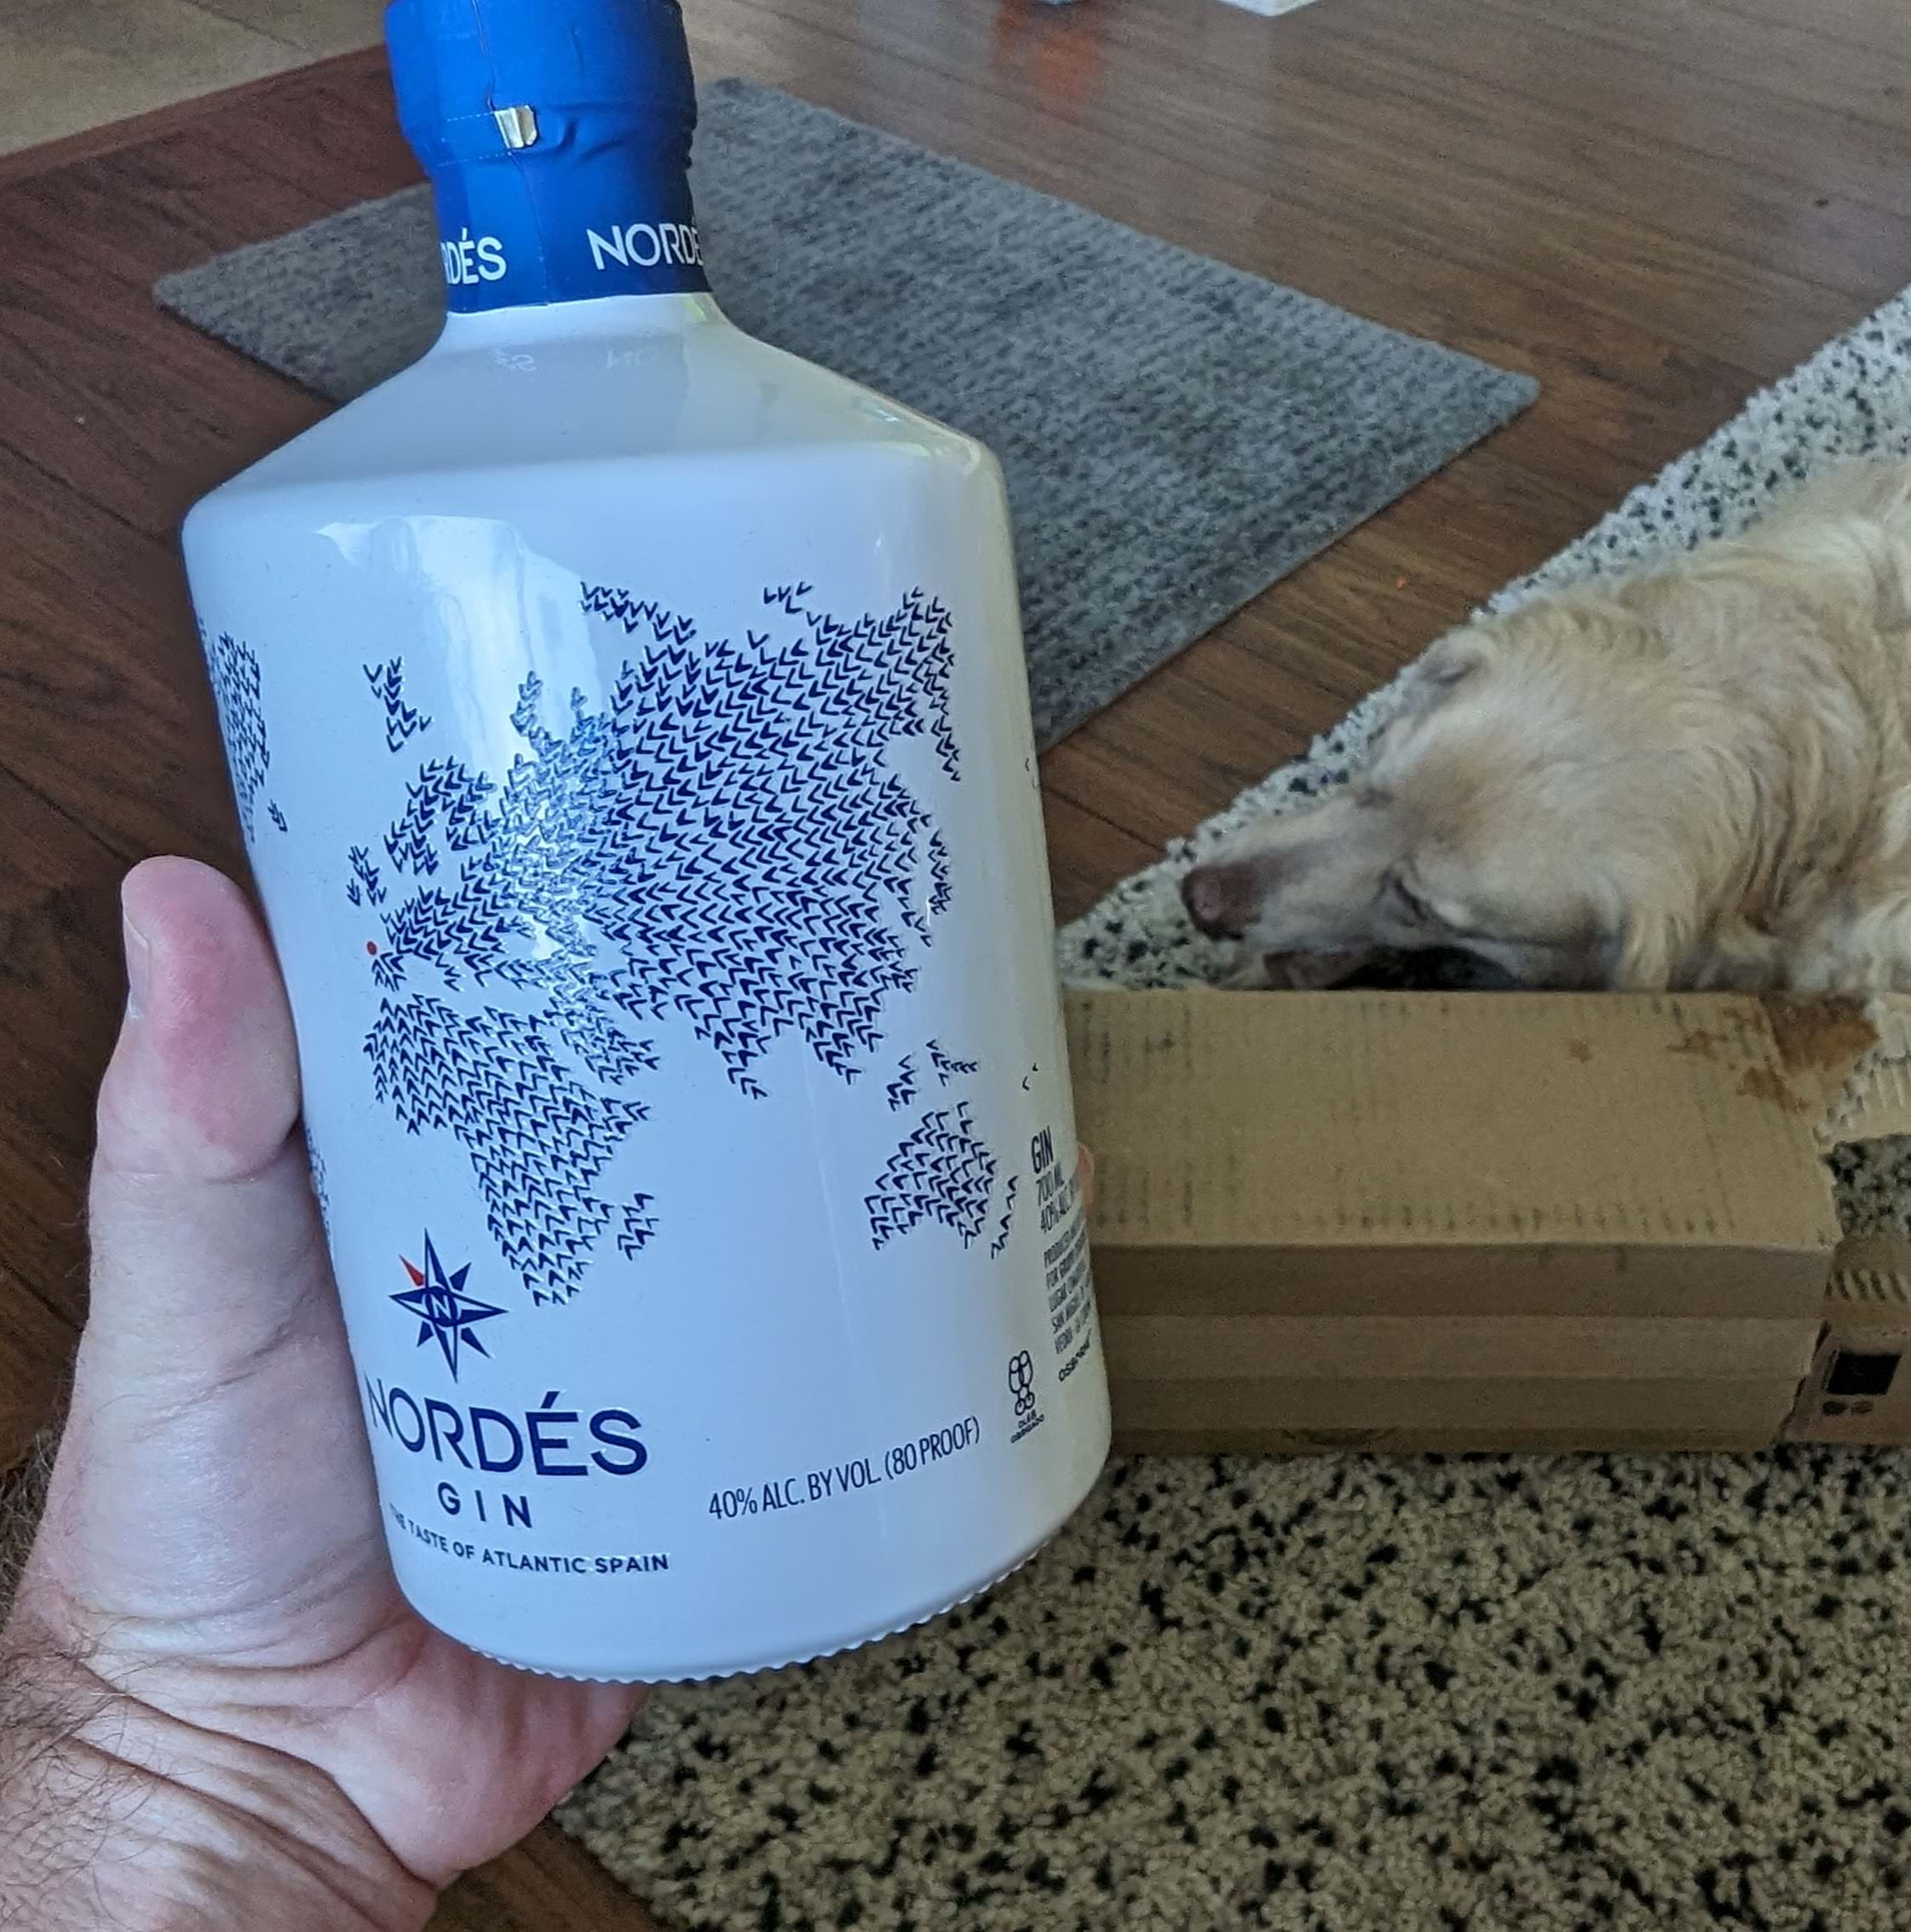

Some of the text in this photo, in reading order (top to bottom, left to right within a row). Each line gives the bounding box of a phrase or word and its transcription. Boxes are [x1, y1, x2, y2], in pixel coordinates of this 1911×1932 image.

[1031, 1124, 1054, 1175] GIN
[431, 1293, 452, 1320] N
[364, 1372, 648, 1476] NORDÉS
[709, 1415, 981, 1520] 40% ALC. BY VOL. (80 PROOF)
[437, 1481, 533, 1529] GIN
[407, 1519, 449, 1553] TASTE
[453, 1539, 475, 1561] OF
[481, 1548, 587, 1574] ATLANTIC
[595, 1554, 670, 1574] SPAIN
